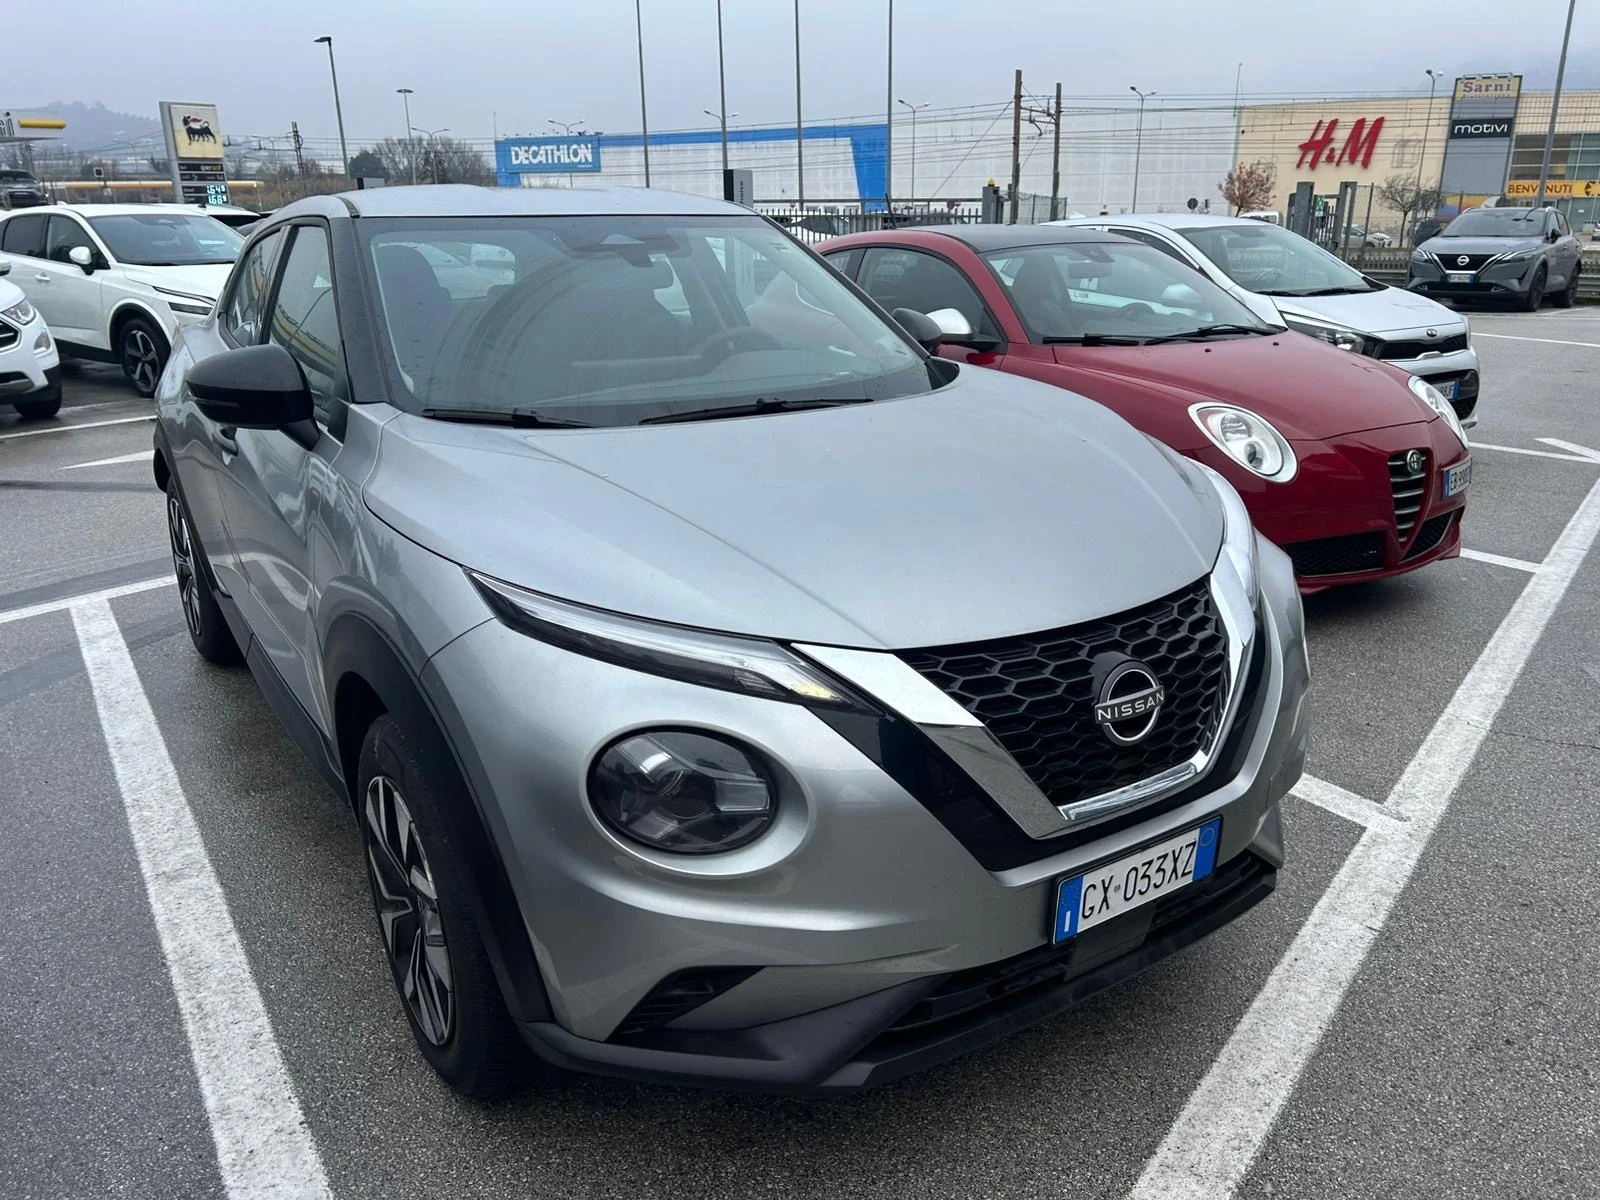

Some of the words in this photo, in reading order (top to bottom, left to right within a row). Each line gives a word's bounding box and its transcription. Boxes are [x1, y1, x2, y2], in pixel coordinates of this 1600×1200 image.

[1463, 79, 1511, 93] Sarni
[1454, 124, 1508, 134] motivi
[1296, 116, 1385, 170] H&M
[511, 144, 592, 164] DECATHLON
[1508, 184, 1572, 194] BENVNUTI
[1098, 690, 1164, 721] NISSAN
[1081, 875, 1114, 919] GX
[1123, 841, 1197, 902] 033XZ
